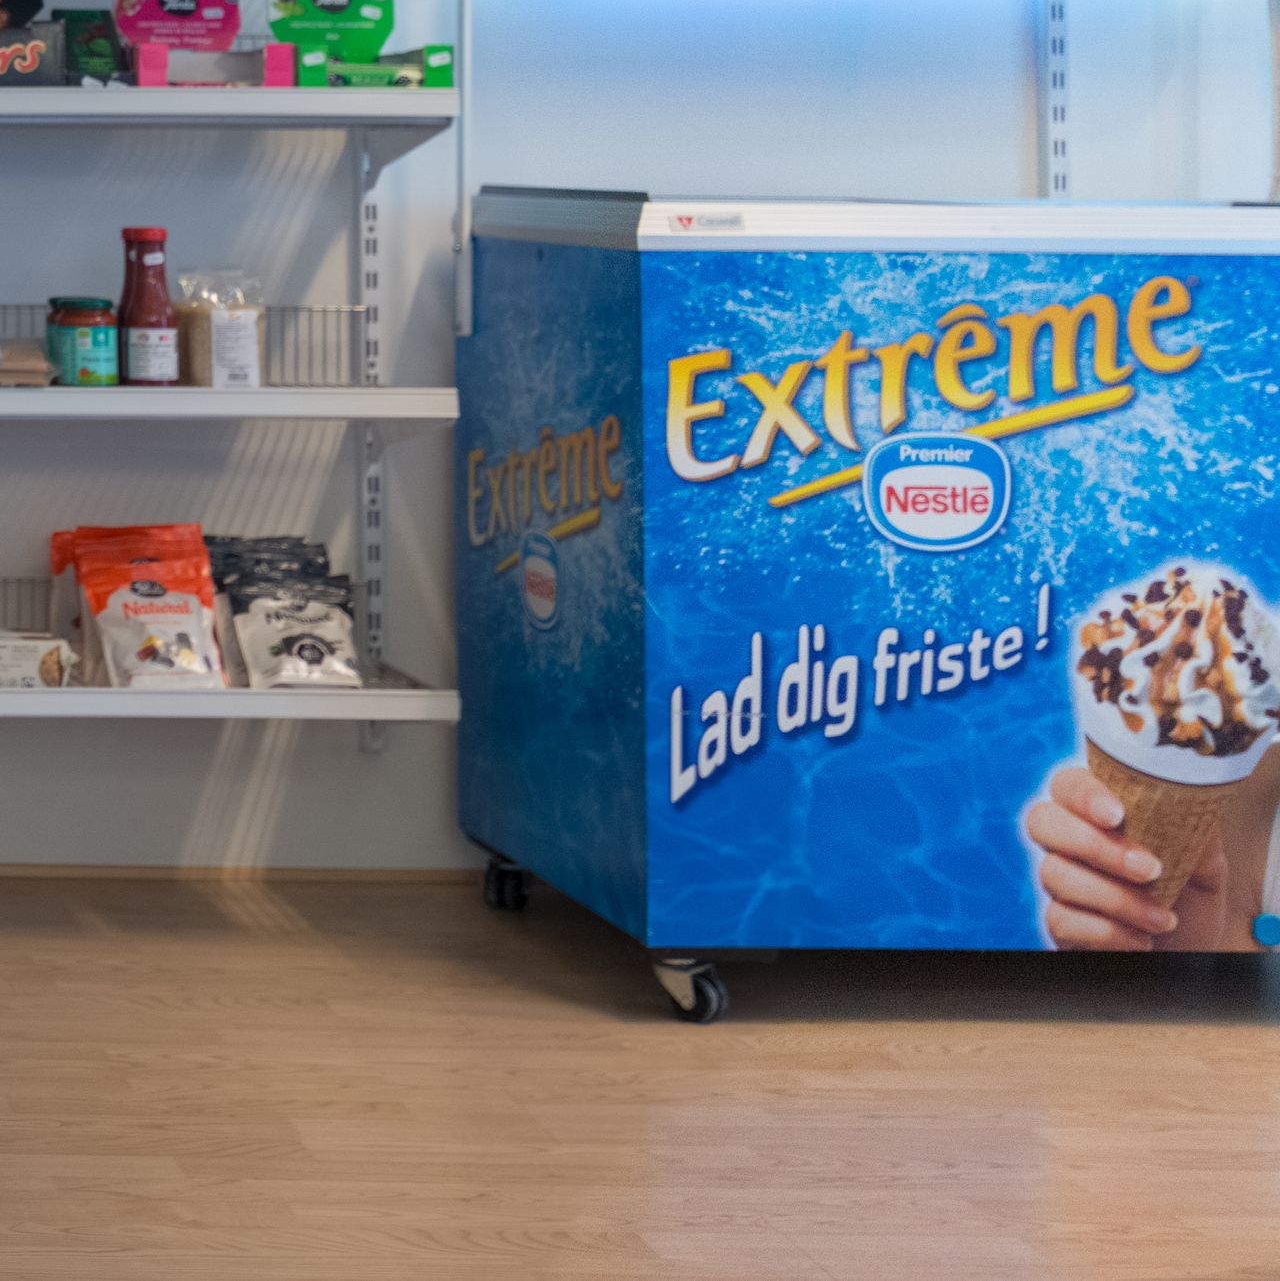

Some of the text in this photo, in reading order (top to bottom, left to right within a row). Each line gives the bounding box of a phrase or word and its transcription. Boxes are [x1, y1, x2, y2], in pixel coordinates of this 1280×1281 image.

[666, 275, 1202, 483] Extrême
[899, 444, 974, 464] Premier
[468, 415, 624, 547] Extrême
[671, 631, 762, 804] Lad
[777, 623, 859, 739] dig
